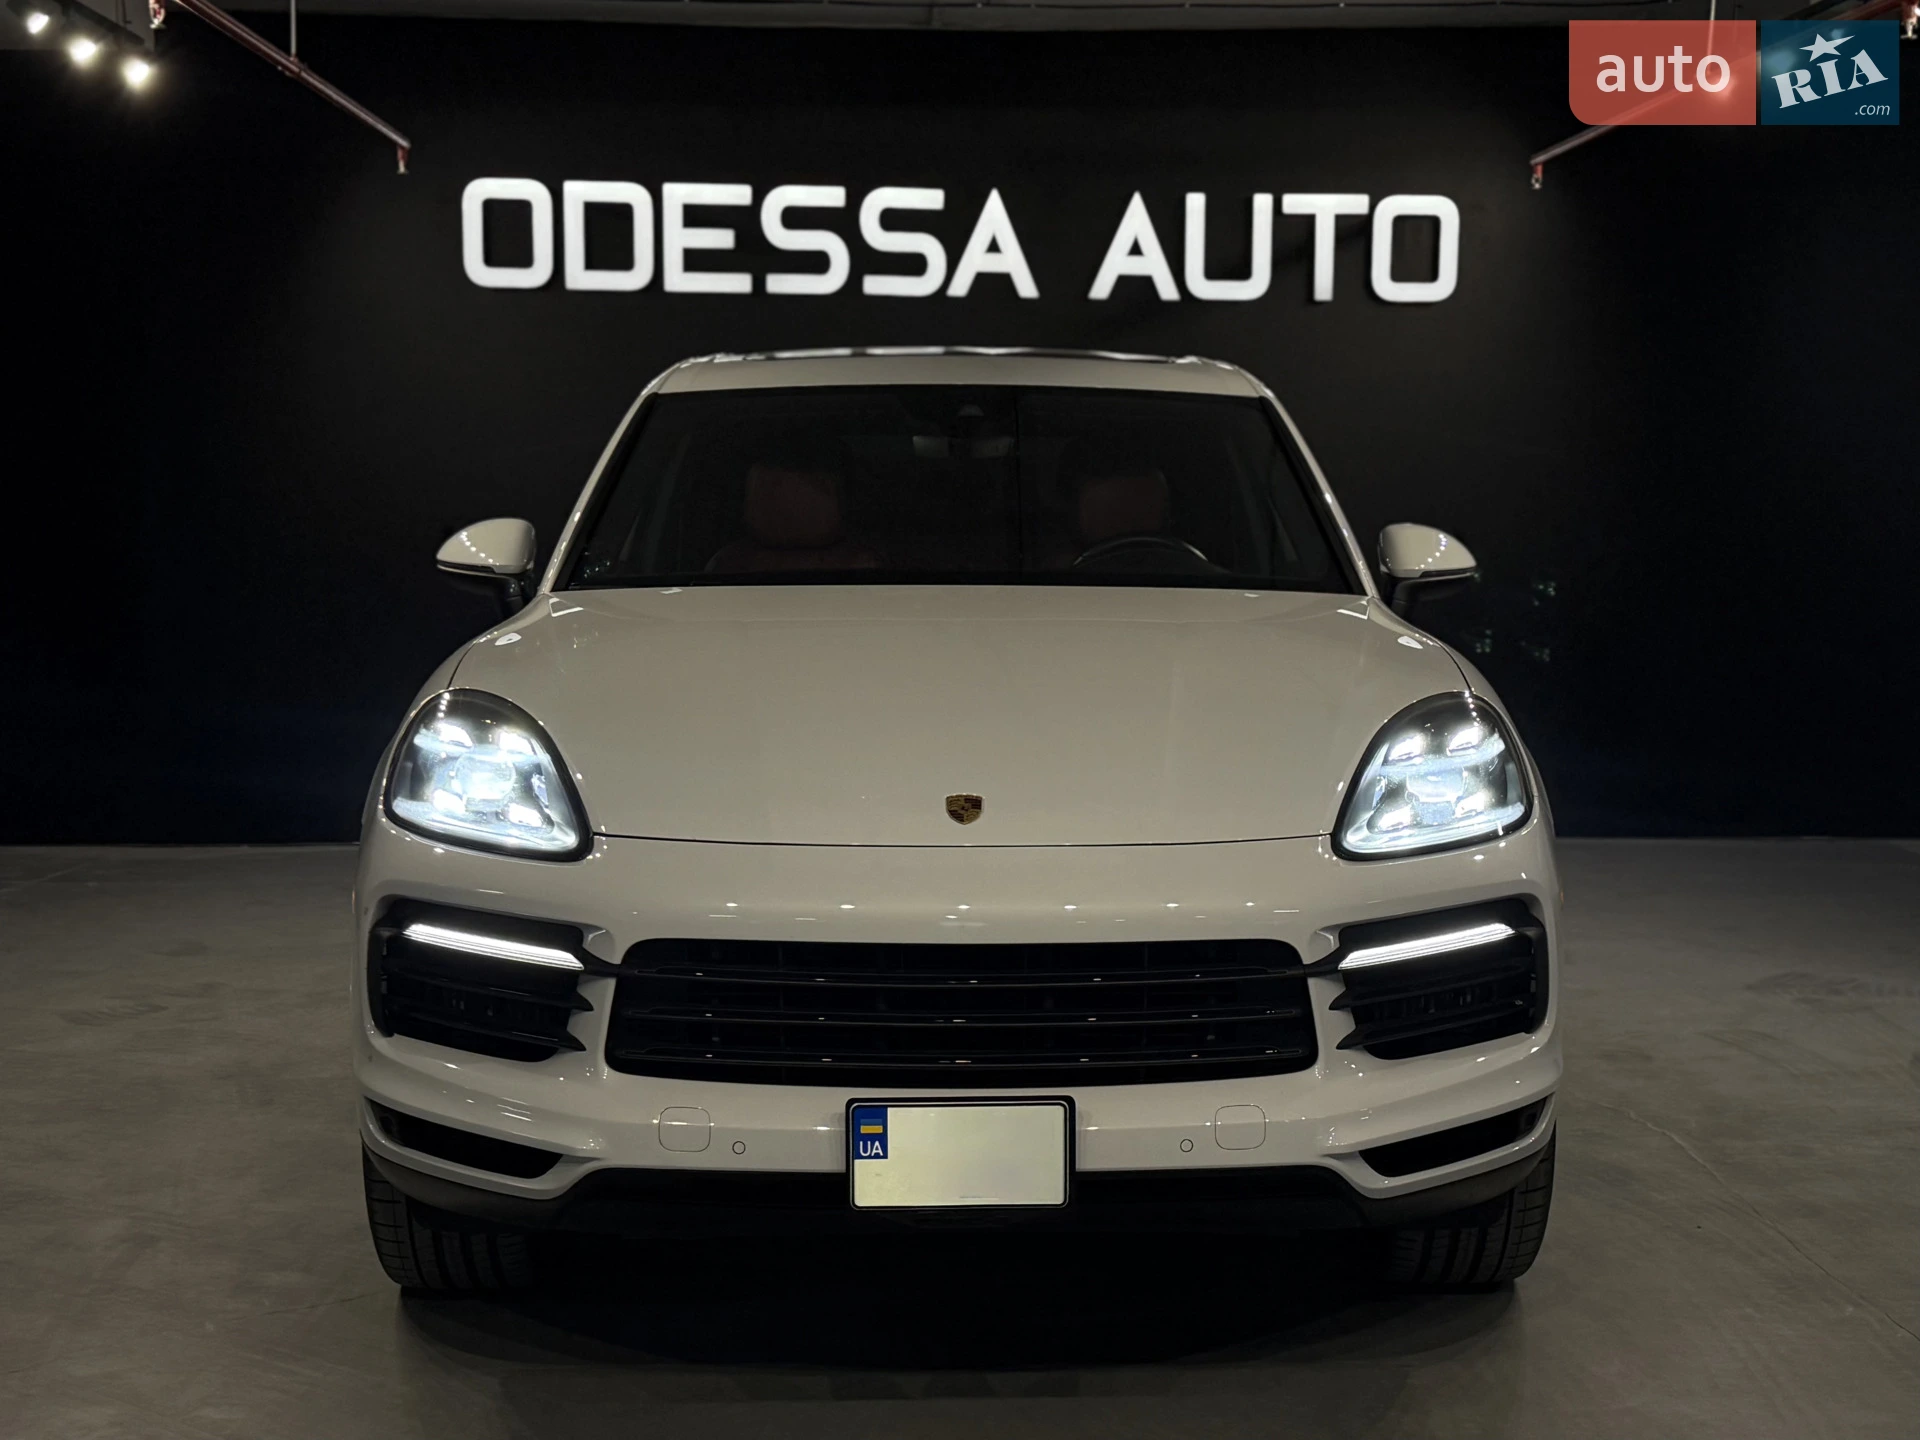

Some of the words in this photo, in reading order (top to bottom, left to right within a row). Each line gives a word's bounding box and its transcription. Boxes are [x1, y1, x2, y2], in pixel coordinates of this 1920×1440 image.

[461, 177, 1039, 299] ODESSA
[1088, 191, 1460, 303] AUTO
[859, 1140, 884, 1157] UA
